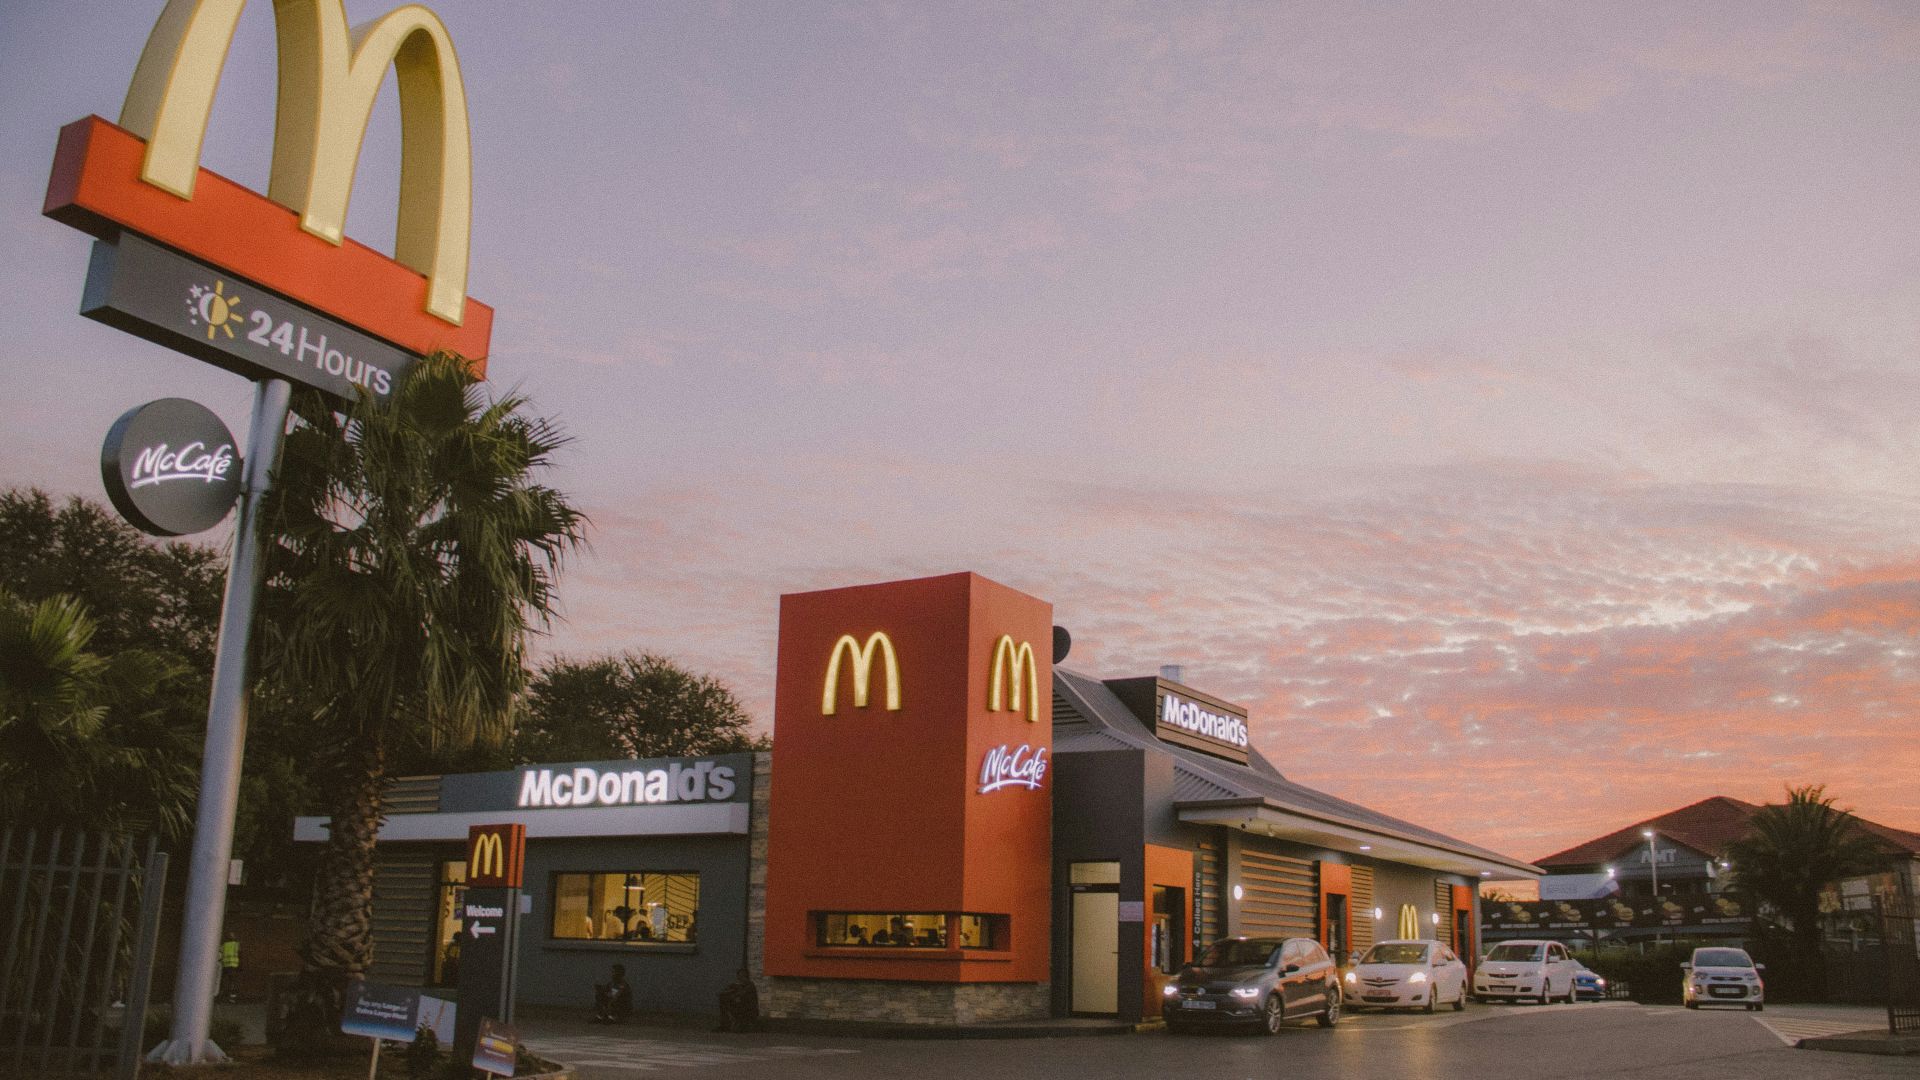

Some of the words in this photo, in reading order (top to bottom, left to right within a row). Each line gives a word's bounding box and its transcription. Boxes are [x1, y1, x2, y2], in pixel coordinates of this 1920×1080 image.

[1160, 693, 1249, 748] McDonald's
[518, 760, 737, 808] McDonald's
[466, 904, 504, 917] Welcome
